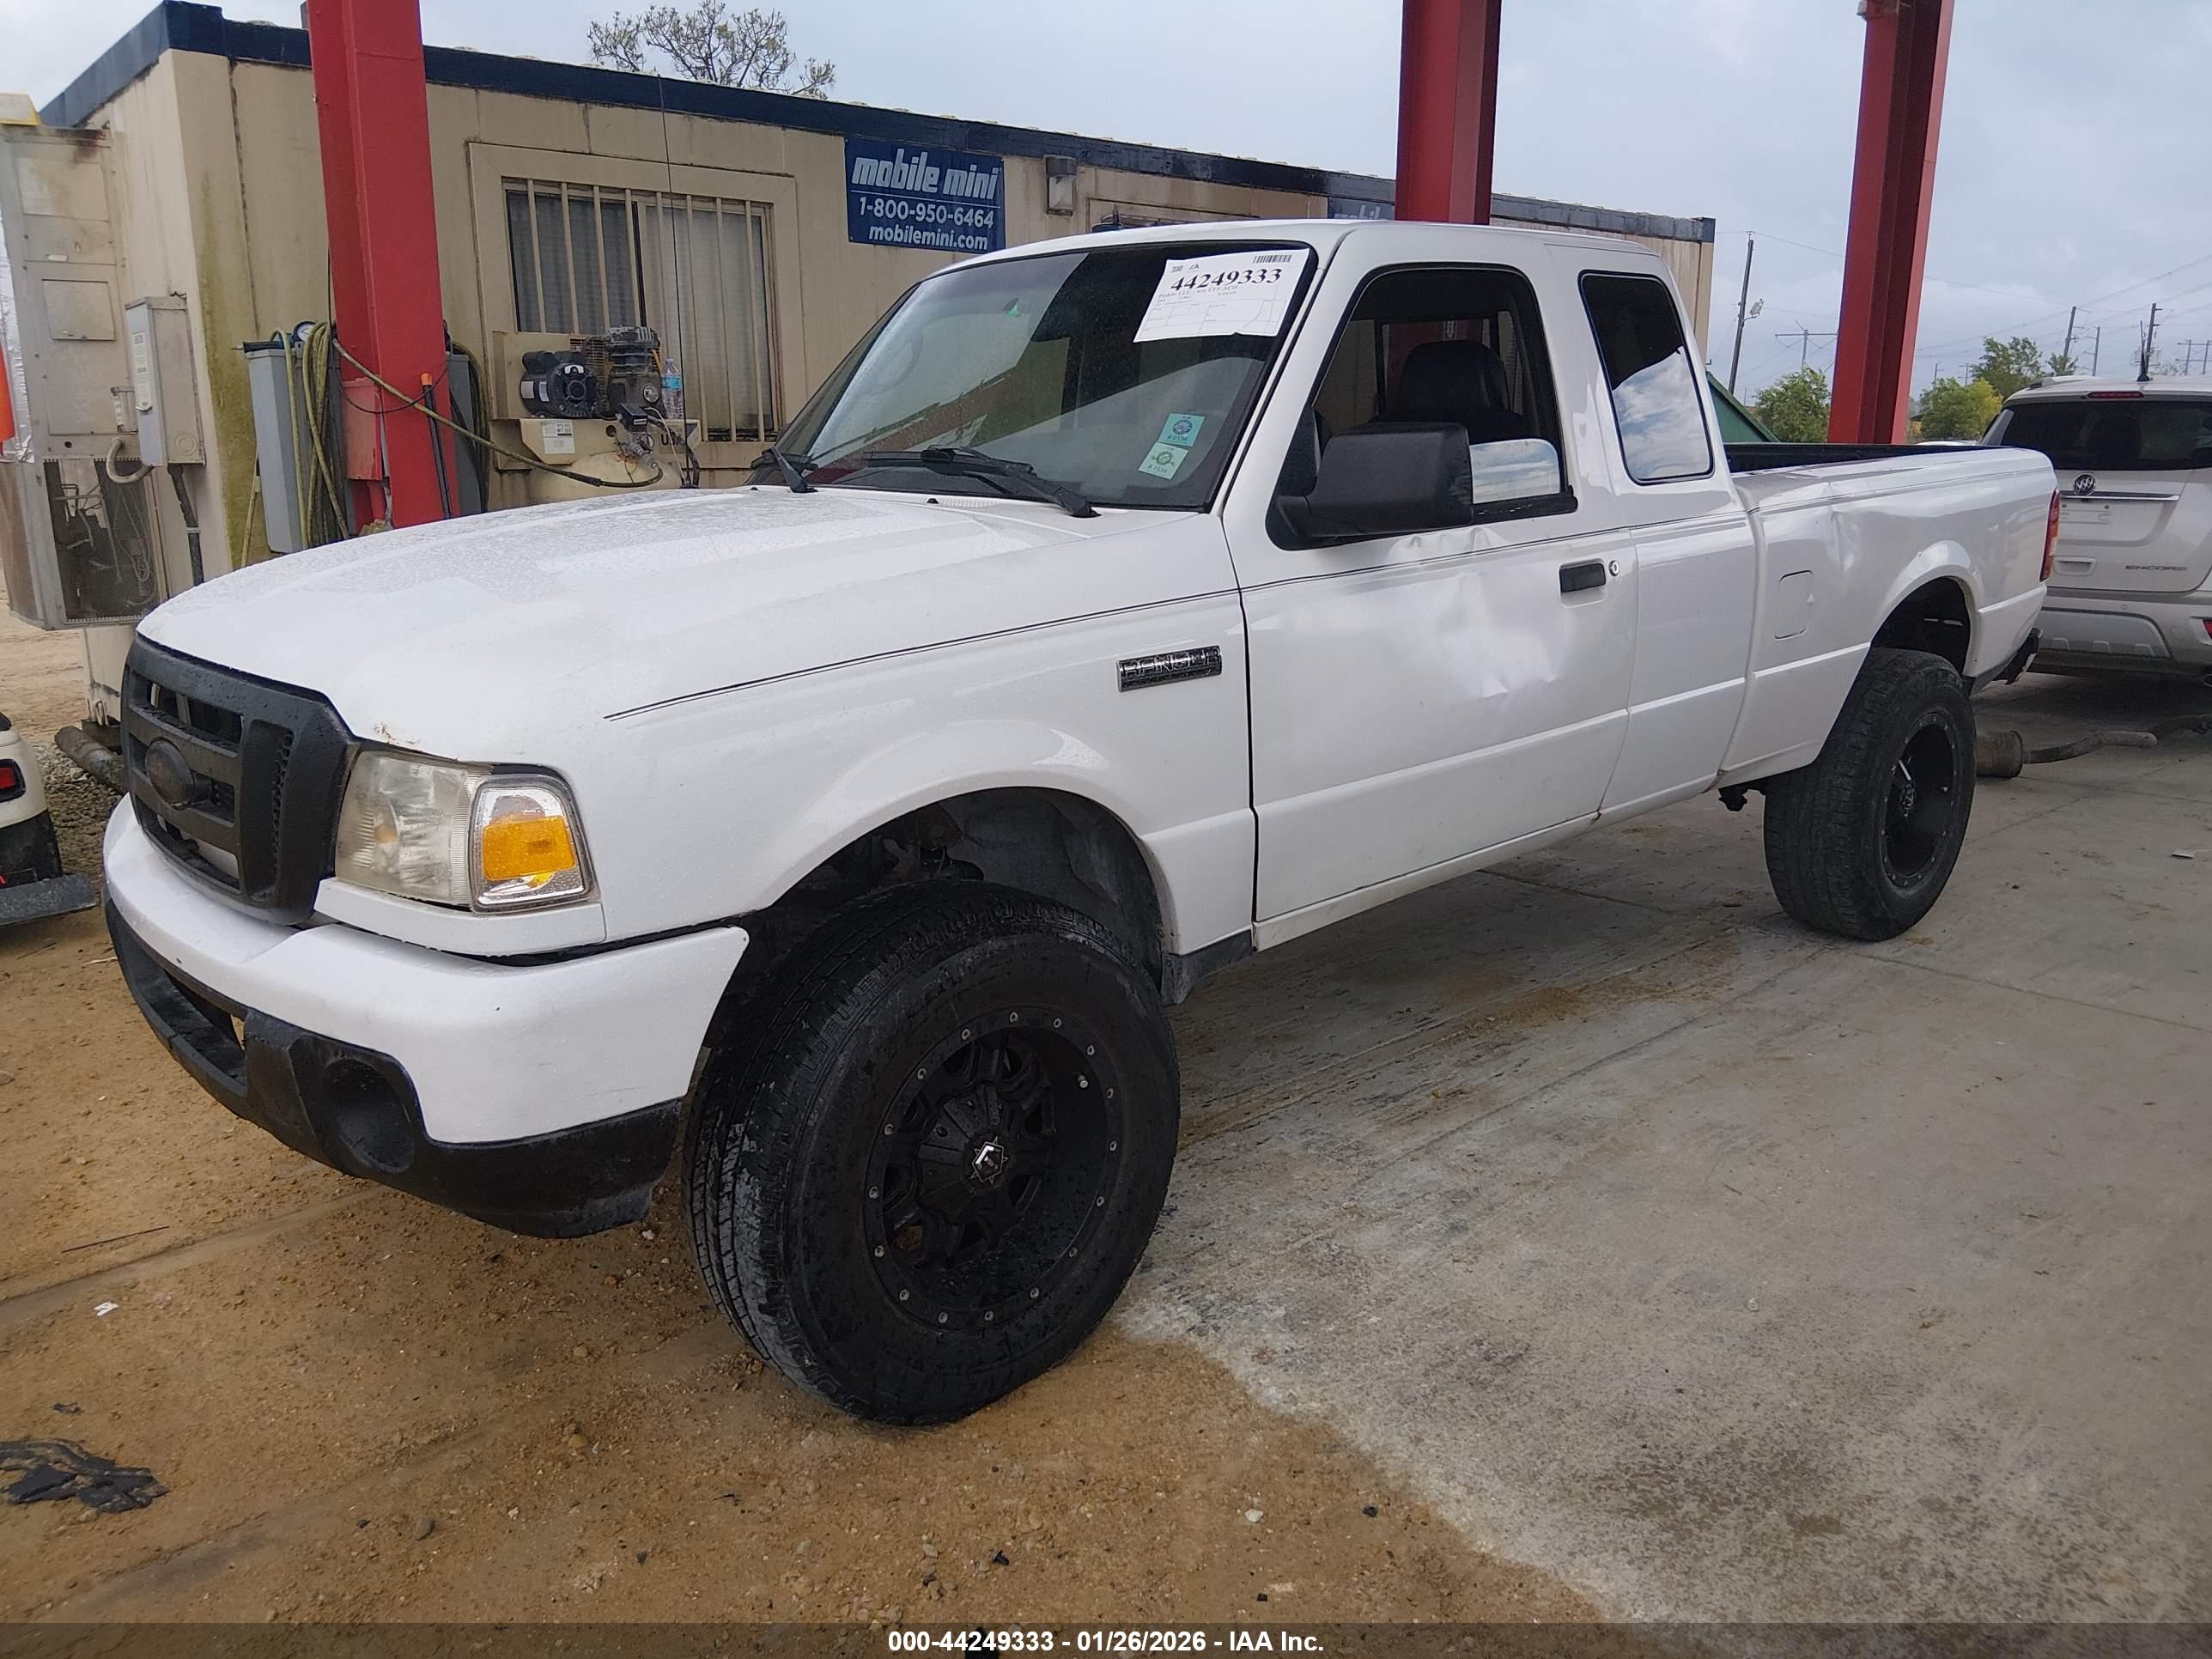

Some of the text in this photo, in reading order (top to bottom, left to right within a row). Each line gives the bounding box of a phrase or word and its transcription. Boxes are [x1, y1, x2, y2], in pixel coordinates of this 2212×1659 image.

[852, 149, 998, 200] mobile mini
[860, 197, 994, 228] 1-800-950-6464
[869, 224, 988, 251] mobilemini.com
[1170, 268, 1283, 291] 44249333
